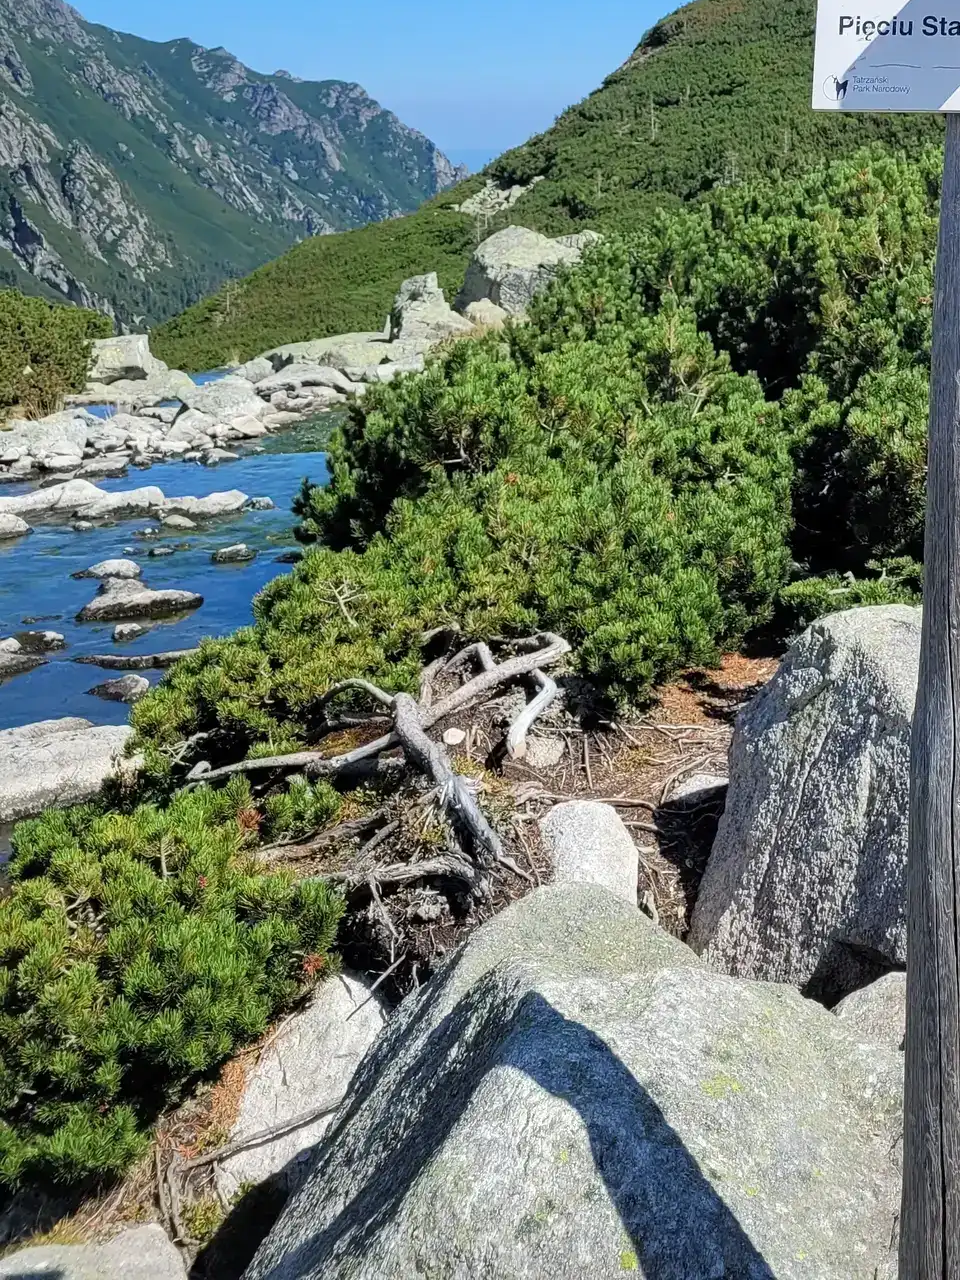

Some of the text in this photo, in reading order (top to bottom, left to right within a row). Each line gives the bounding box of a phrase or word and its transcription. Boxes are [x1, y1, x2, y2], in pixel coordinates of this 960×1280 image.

[838, 15, 913, 41] Pięciu
[852, 75, 888, 84] Tatrzańsk
[852, 84, 911, 95] Park Narodowy
